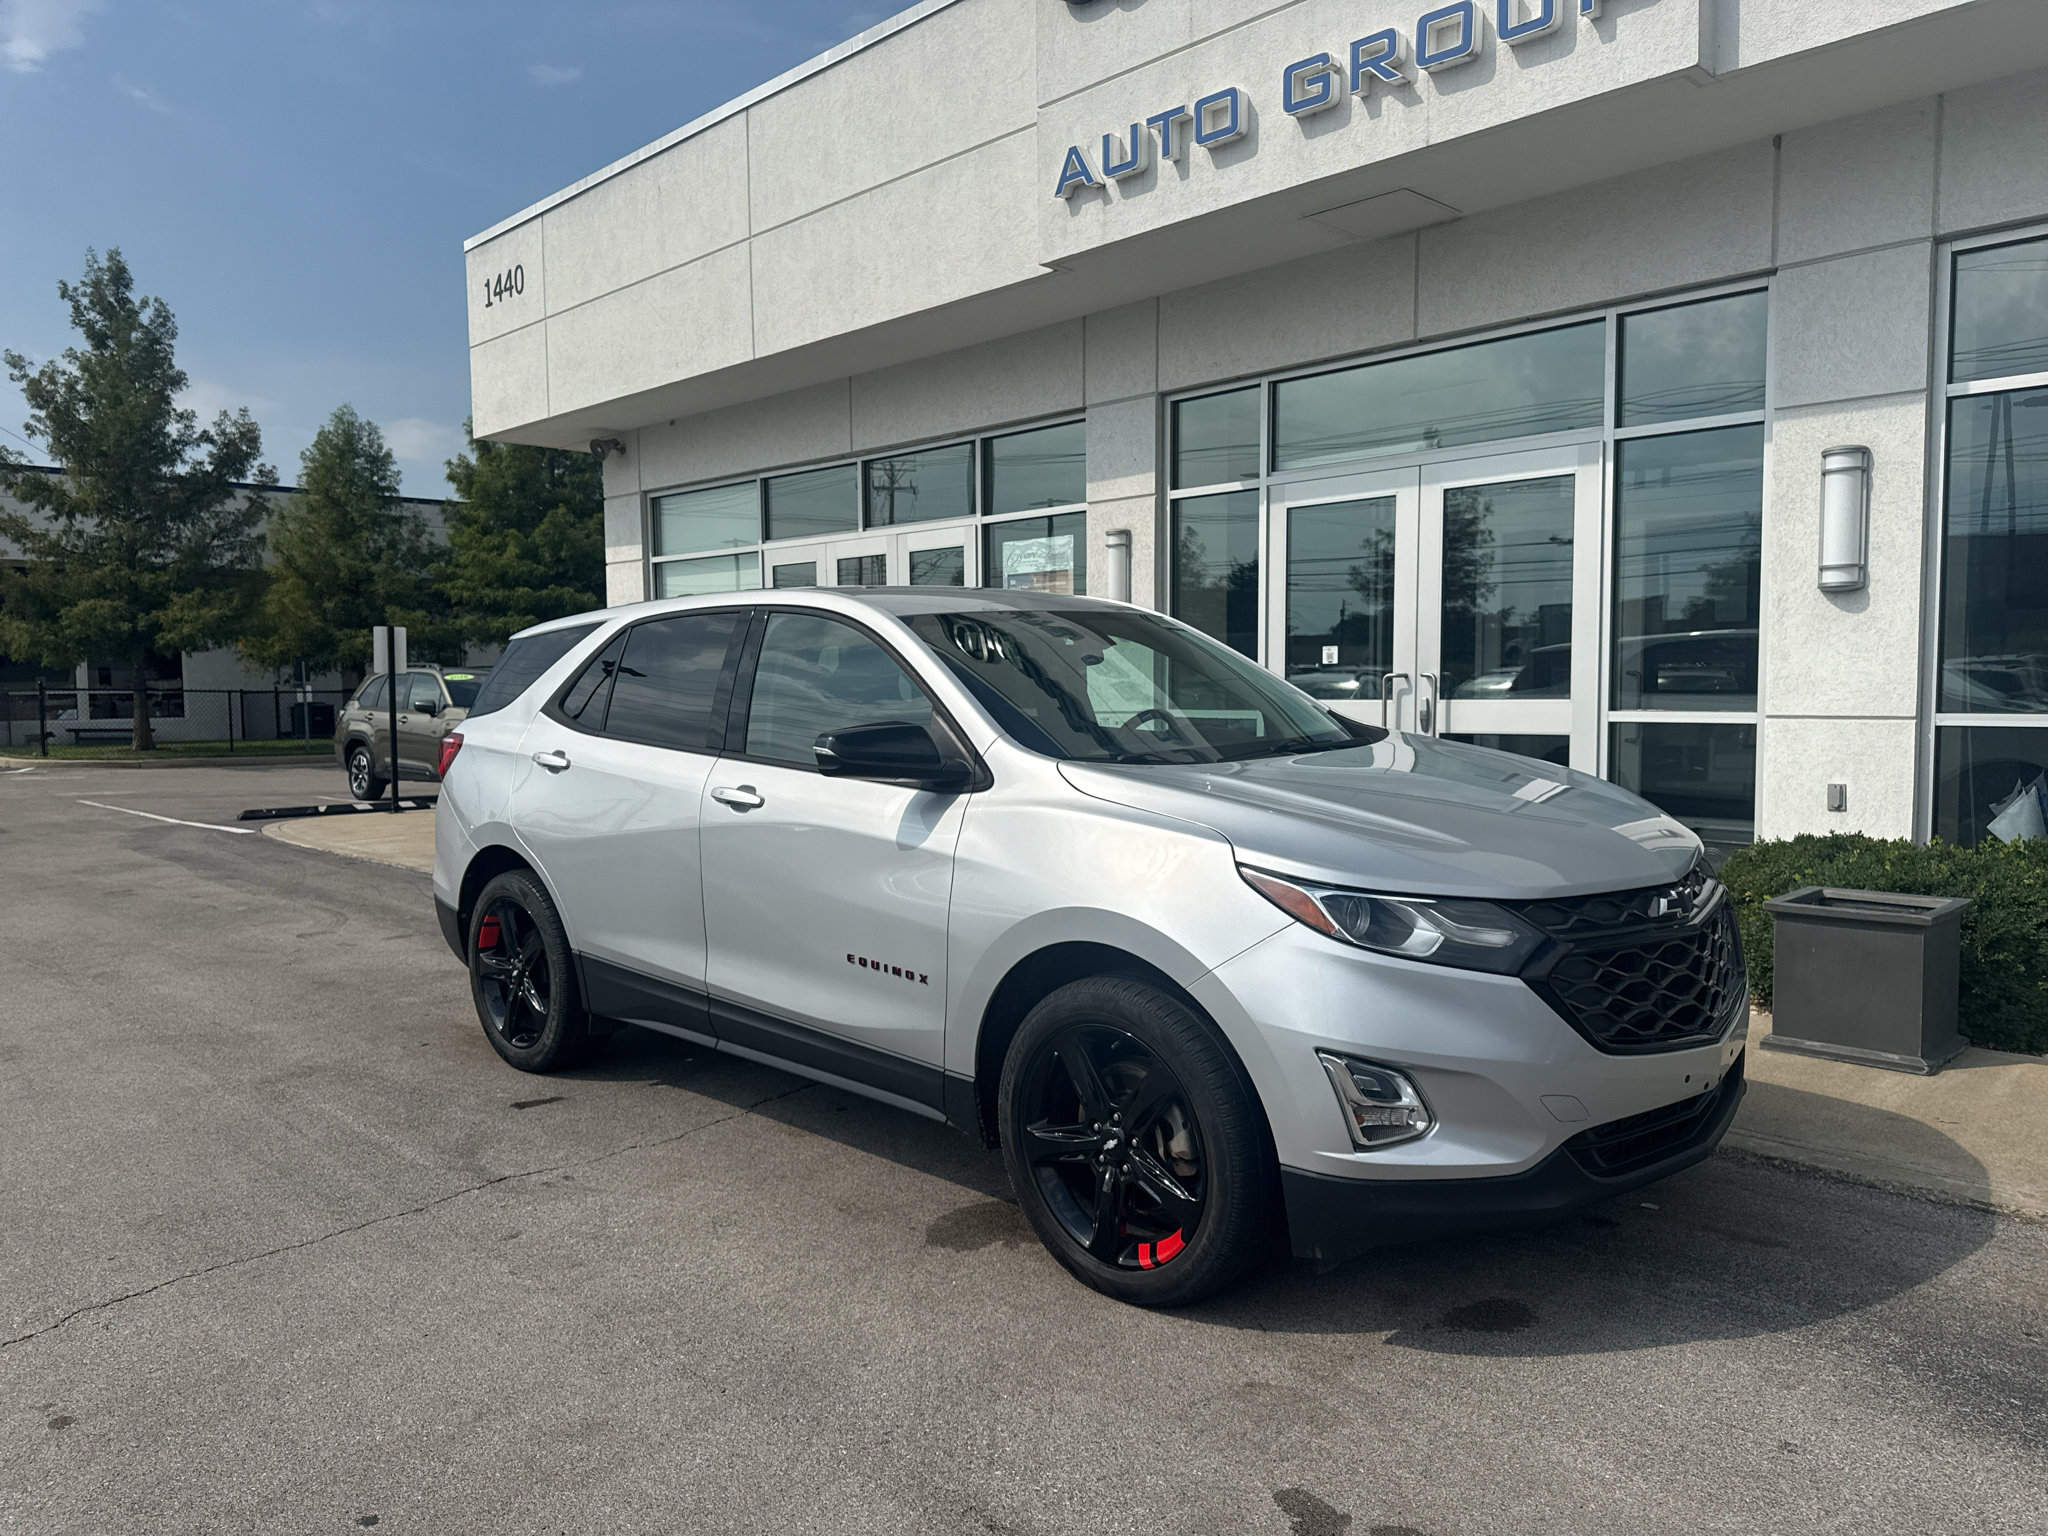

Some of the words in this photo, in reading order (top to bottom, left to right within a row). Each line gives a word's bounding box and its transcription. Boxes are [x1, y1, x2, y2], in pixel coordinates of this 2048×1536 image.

[1054, 86, 1248, 199] AUTO
[1282, 0, 1598, 117] GROU
[484, 264, 525, 308] 1440
[846, 953, 929, 986] EQUINOX
